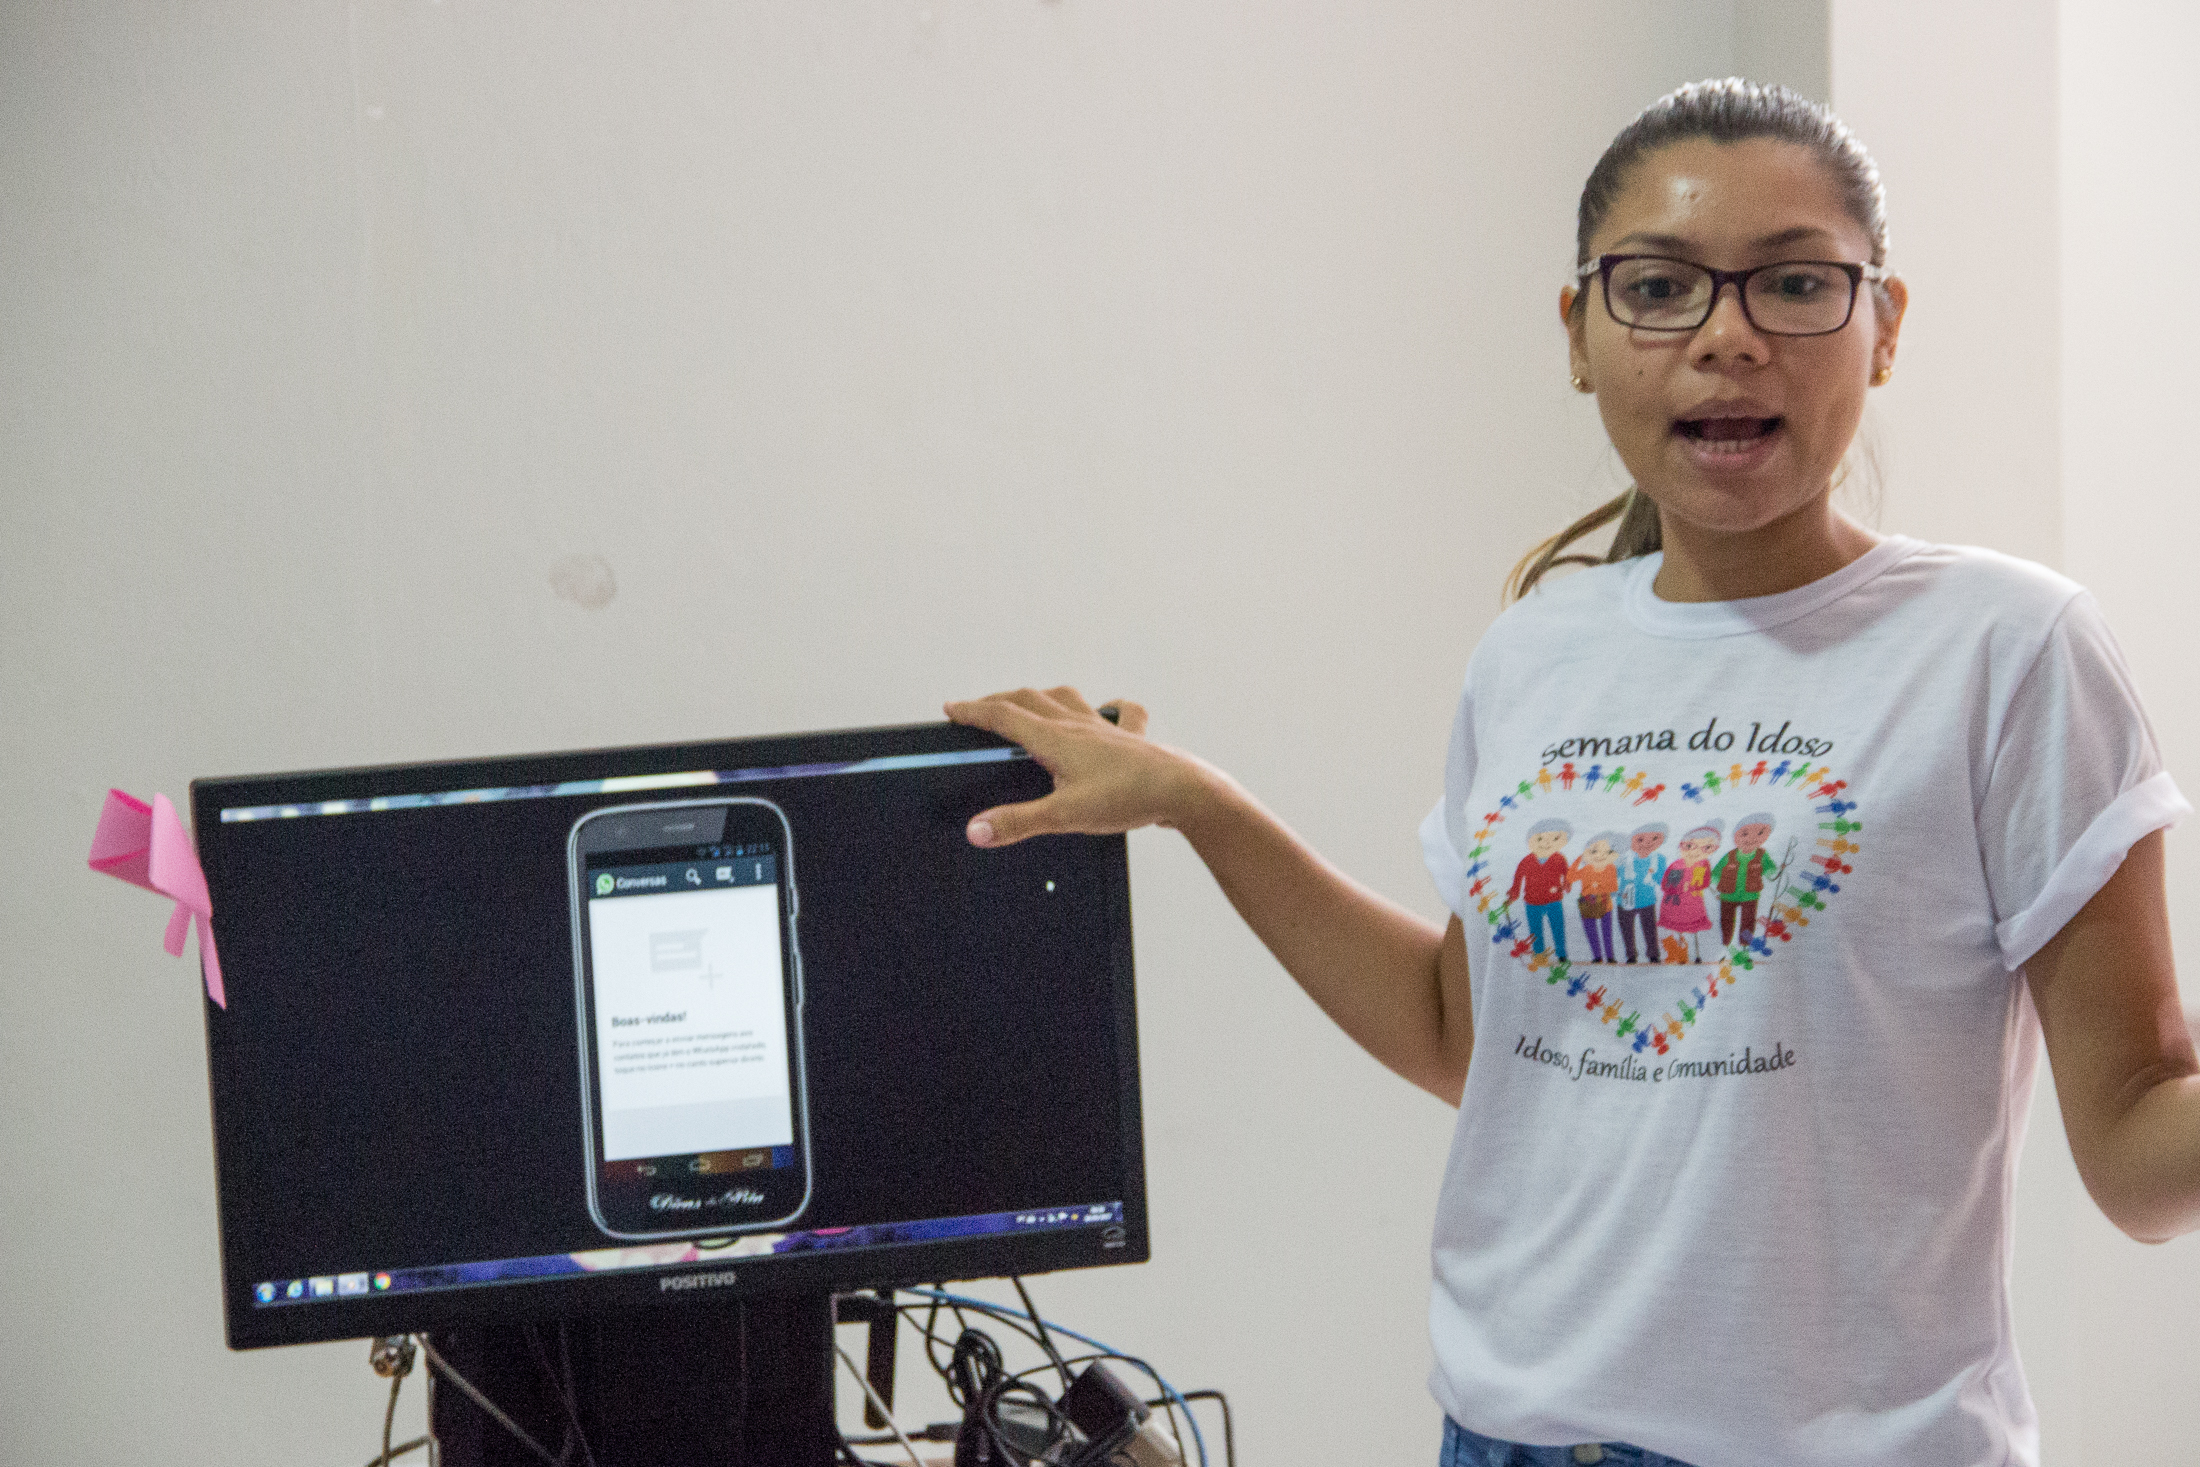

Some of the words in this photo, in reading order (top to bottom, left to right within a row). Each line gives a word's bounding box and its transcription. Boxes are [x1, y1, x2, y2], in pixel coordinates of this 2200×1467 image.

[1688, 717, 1735, 752] do
[1746, 720, 1833, 757] Idoso
[611, 1011, 687, 1028] Boas-vindas!
[1515, 1035, 1573, 1074] Idoso,
[1572, 1047, 1647, 1082] família
[1653, 1066, 1664, 1083] e
[659, 1271, 736, 1292] POSITIVO
